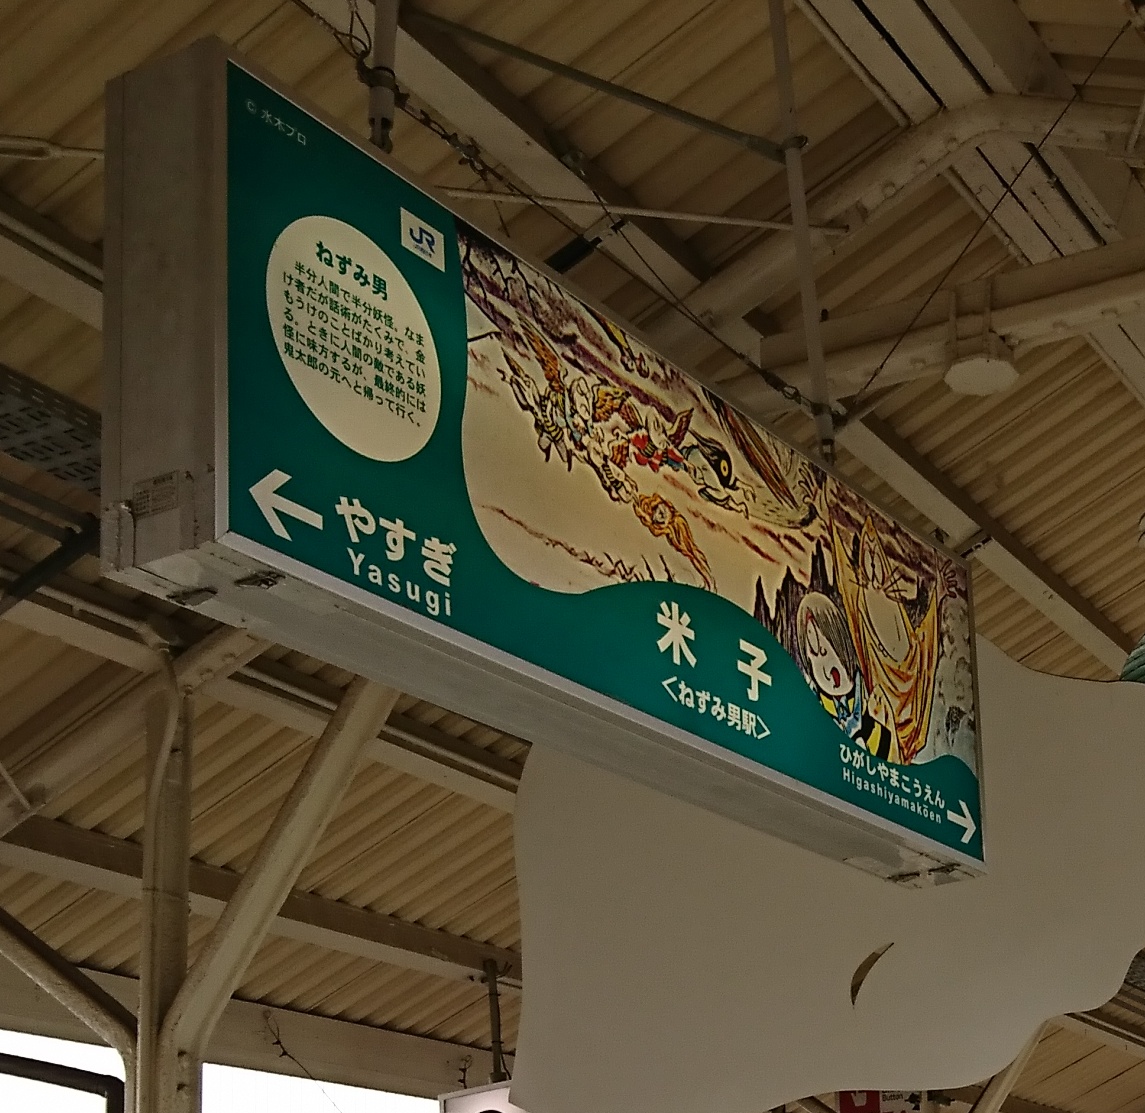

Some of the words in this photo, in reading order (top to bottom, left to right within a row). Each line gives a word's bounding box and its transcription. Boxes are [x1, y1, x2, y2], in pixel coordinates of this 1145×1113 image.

[315, 240, 388, 301] ねずみ男
[409, 226, 436, 255] JR
[284, 289, 426, 378] もうけのことばかり考えてい
[335, 496, 457, 587] やすぎ
[347, 547, 451, 616] Yasugi
[657, 601, 772, 701] 米子
[839, 744, 945, 809] ひがしやまこうえん
[842, 767, 942, 824] Higashiyamakōen
